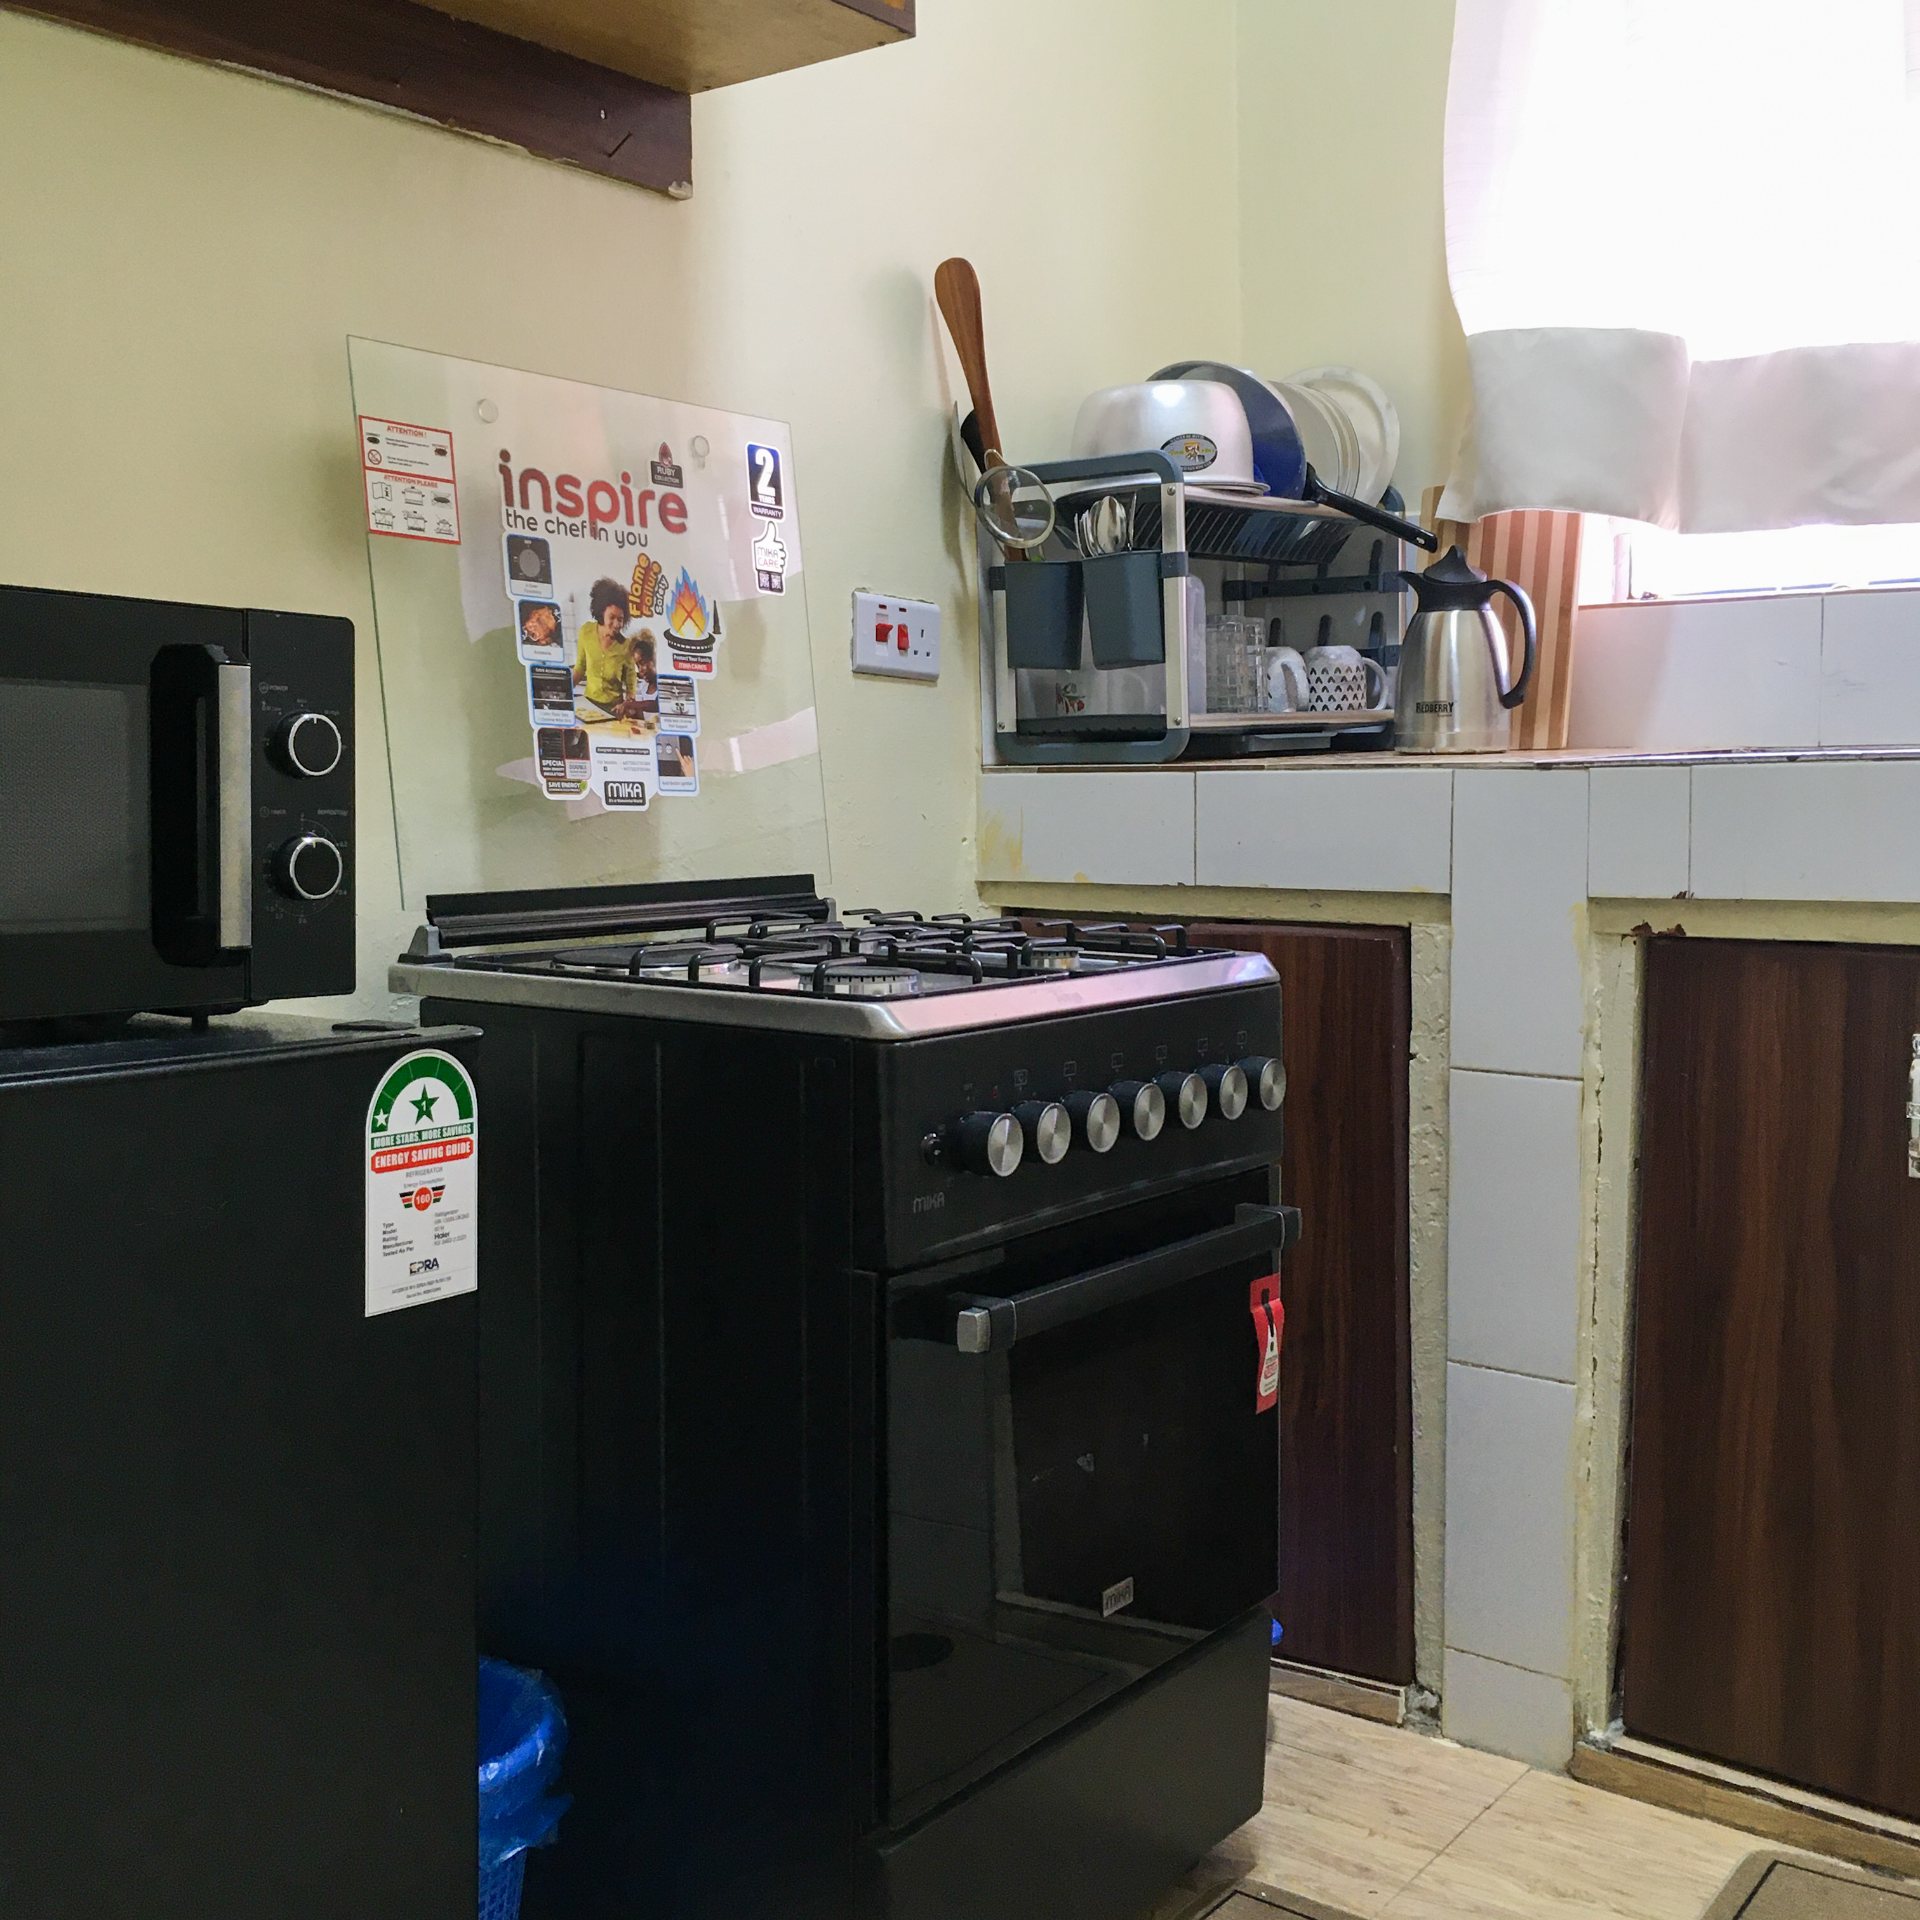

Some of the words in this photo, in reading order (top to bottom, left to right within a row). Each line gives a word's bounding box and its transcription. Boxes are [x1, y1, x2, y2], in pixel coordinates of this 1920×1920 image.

[386, 425, 424, 438] ATTENTION
[657, 466, 676, 476] RUBY
[755, 448, 776, 496] 2
[499, 449, 688, 538] inspire
[753, 506, 782, 518] WARRANTY
[505, 508, 538, 531] the
[544, 516, 587, 539] chef
[615, 530, 648, 549] you
[757, 547, 779, 558] MIKA
[758, 558, 779, 568] CARE
[629, 553, 650, 618] Flame
[642, 561, 662, 618] Failure
[655, 574, 669, 616] Safety
[1415, 701, 1454, 713] REDBERRY
[607, 782, 643, 798] MIKA
[421, 1100, 426, 1111] 1
[373, 1136, 395, 1149] MORE
[421, 1128, 442, 1140] MORE
[442, 1123, 472, 1138] SAVINGS
[375, 1151, 410, 1168] ENERGY
[411, 1145, 444, 1163] SAVING
[445, 1141, 471, 1157] GUIDE
[405, 1167, 443, 1178] REFRIGERATOR
[912, 1191, 945, 1213] MIKA
[409, 1257, 440, 1276] EPRA
